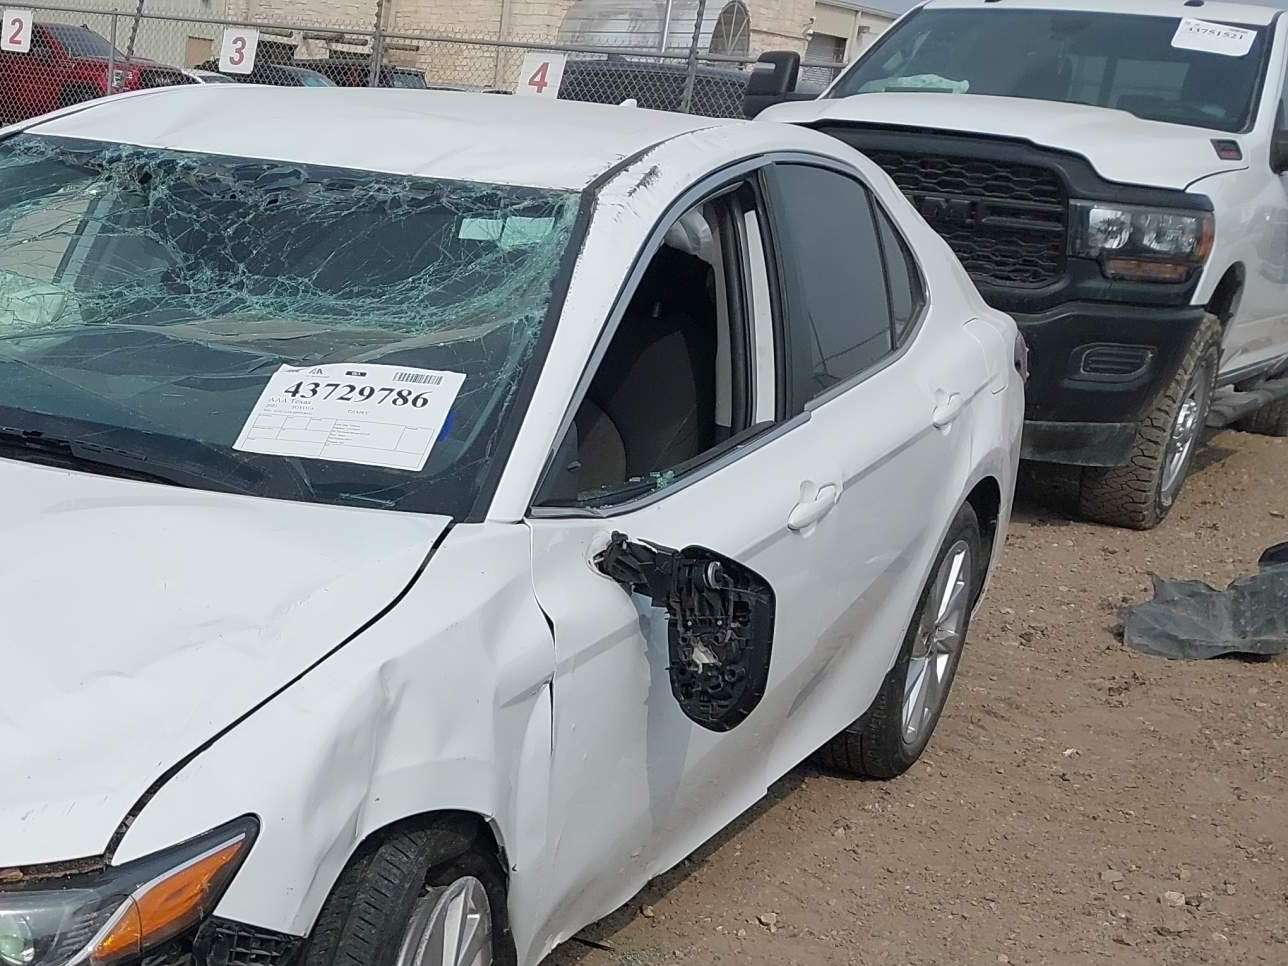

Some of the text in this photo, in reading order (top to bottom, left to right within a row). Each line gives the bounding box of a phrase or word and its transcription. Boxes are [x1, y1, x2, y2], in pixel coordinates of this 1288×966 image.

[9, 18, 24, 45] 2
[229, 36, 247, 66] 3
[528, 62, 550, 94] 4
[284, 380, 432, 408] 43729786
